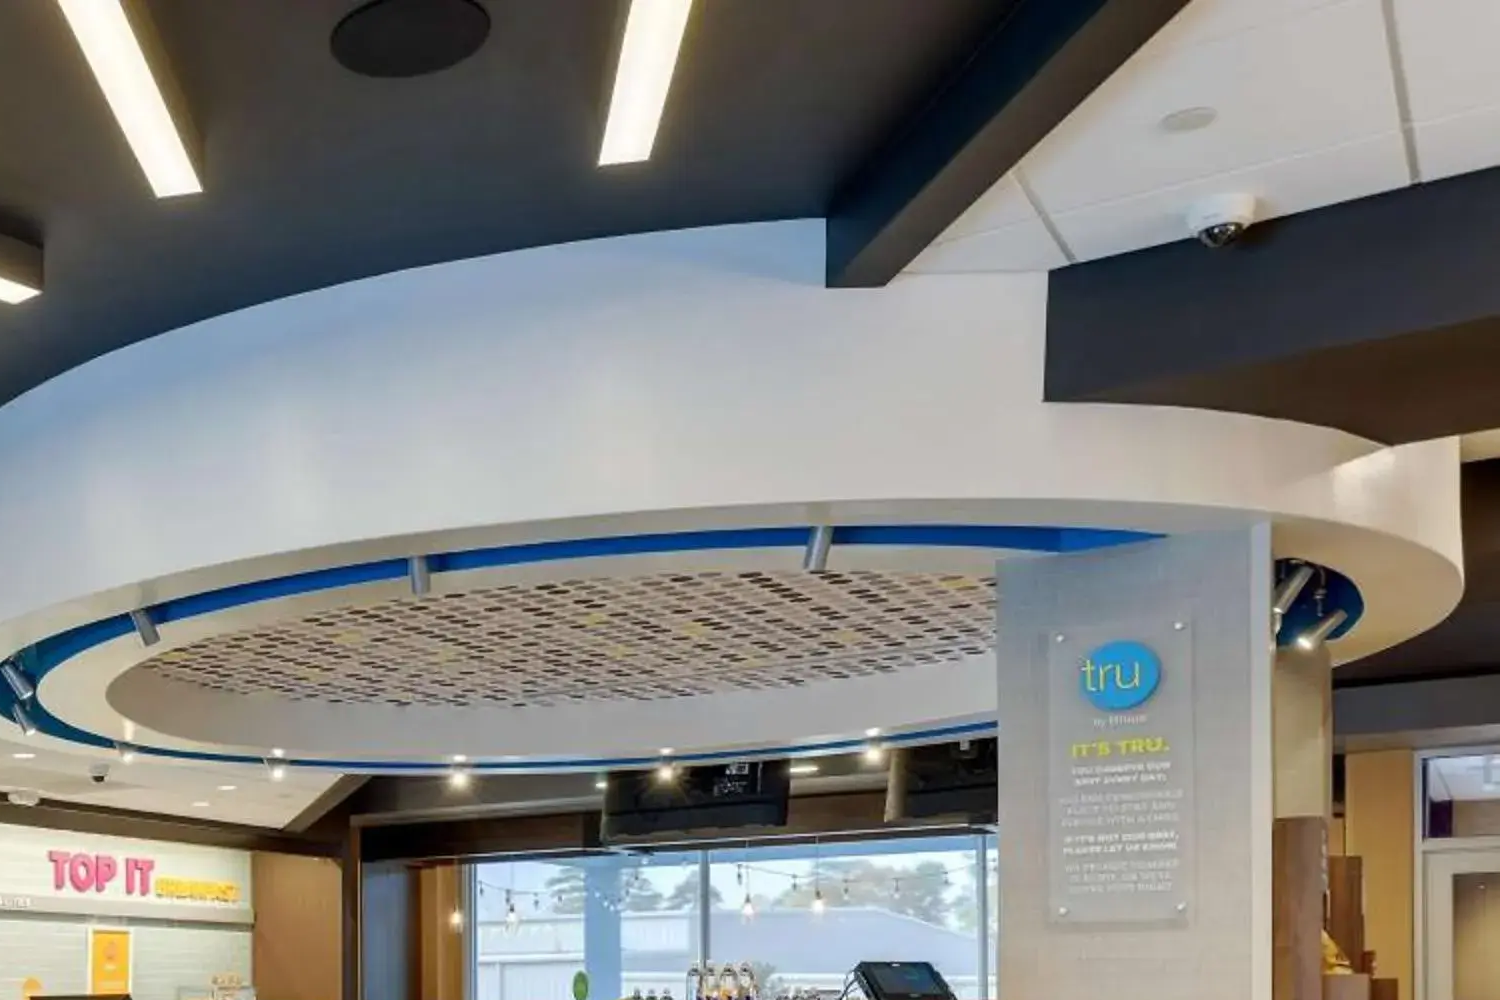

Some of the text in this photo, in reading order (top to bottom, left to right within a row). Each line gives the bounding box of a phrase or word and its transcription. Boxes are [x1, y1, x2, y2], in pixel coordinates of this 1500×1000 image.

[1080, 659, 1140, 692] tru
[1072, 741, 1111, 757] IT'S
[48, 850, 117, 893] TOP
[125, 857, 155, 897] IT
